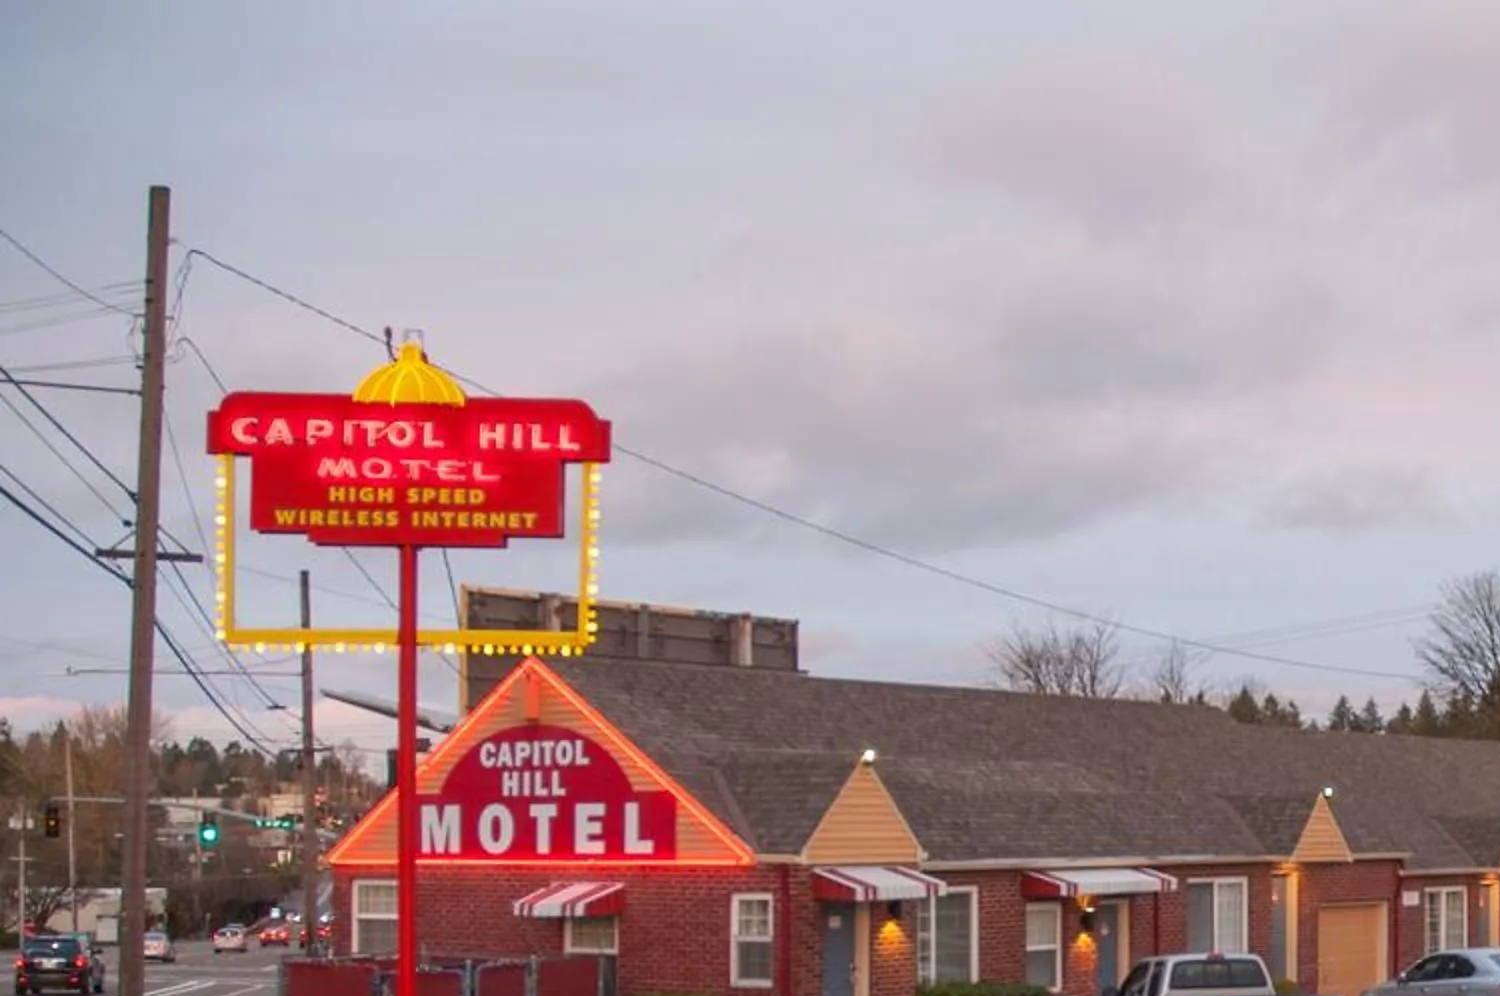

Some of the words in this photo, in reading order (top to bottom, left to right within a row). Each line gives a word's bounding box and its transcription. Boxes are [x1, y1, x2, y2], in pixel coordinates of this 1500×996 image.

[231, 417, 446, 449] CAPITOL
[478, 422, 581, 451] HILL
[316, 457, 501, 481] MOTEL
[328, 486, 394, 504] HIGH
[406, 487, 486, 505] SPEED
[273, 509, 399, 527] WIRELESS
[411, 511, 538, 529] INTERNET
[479, 740, 590, 768] CAPITOL
[501, 771, 566, 797] HILL
[420, 802, 655, 855] MOTEL
